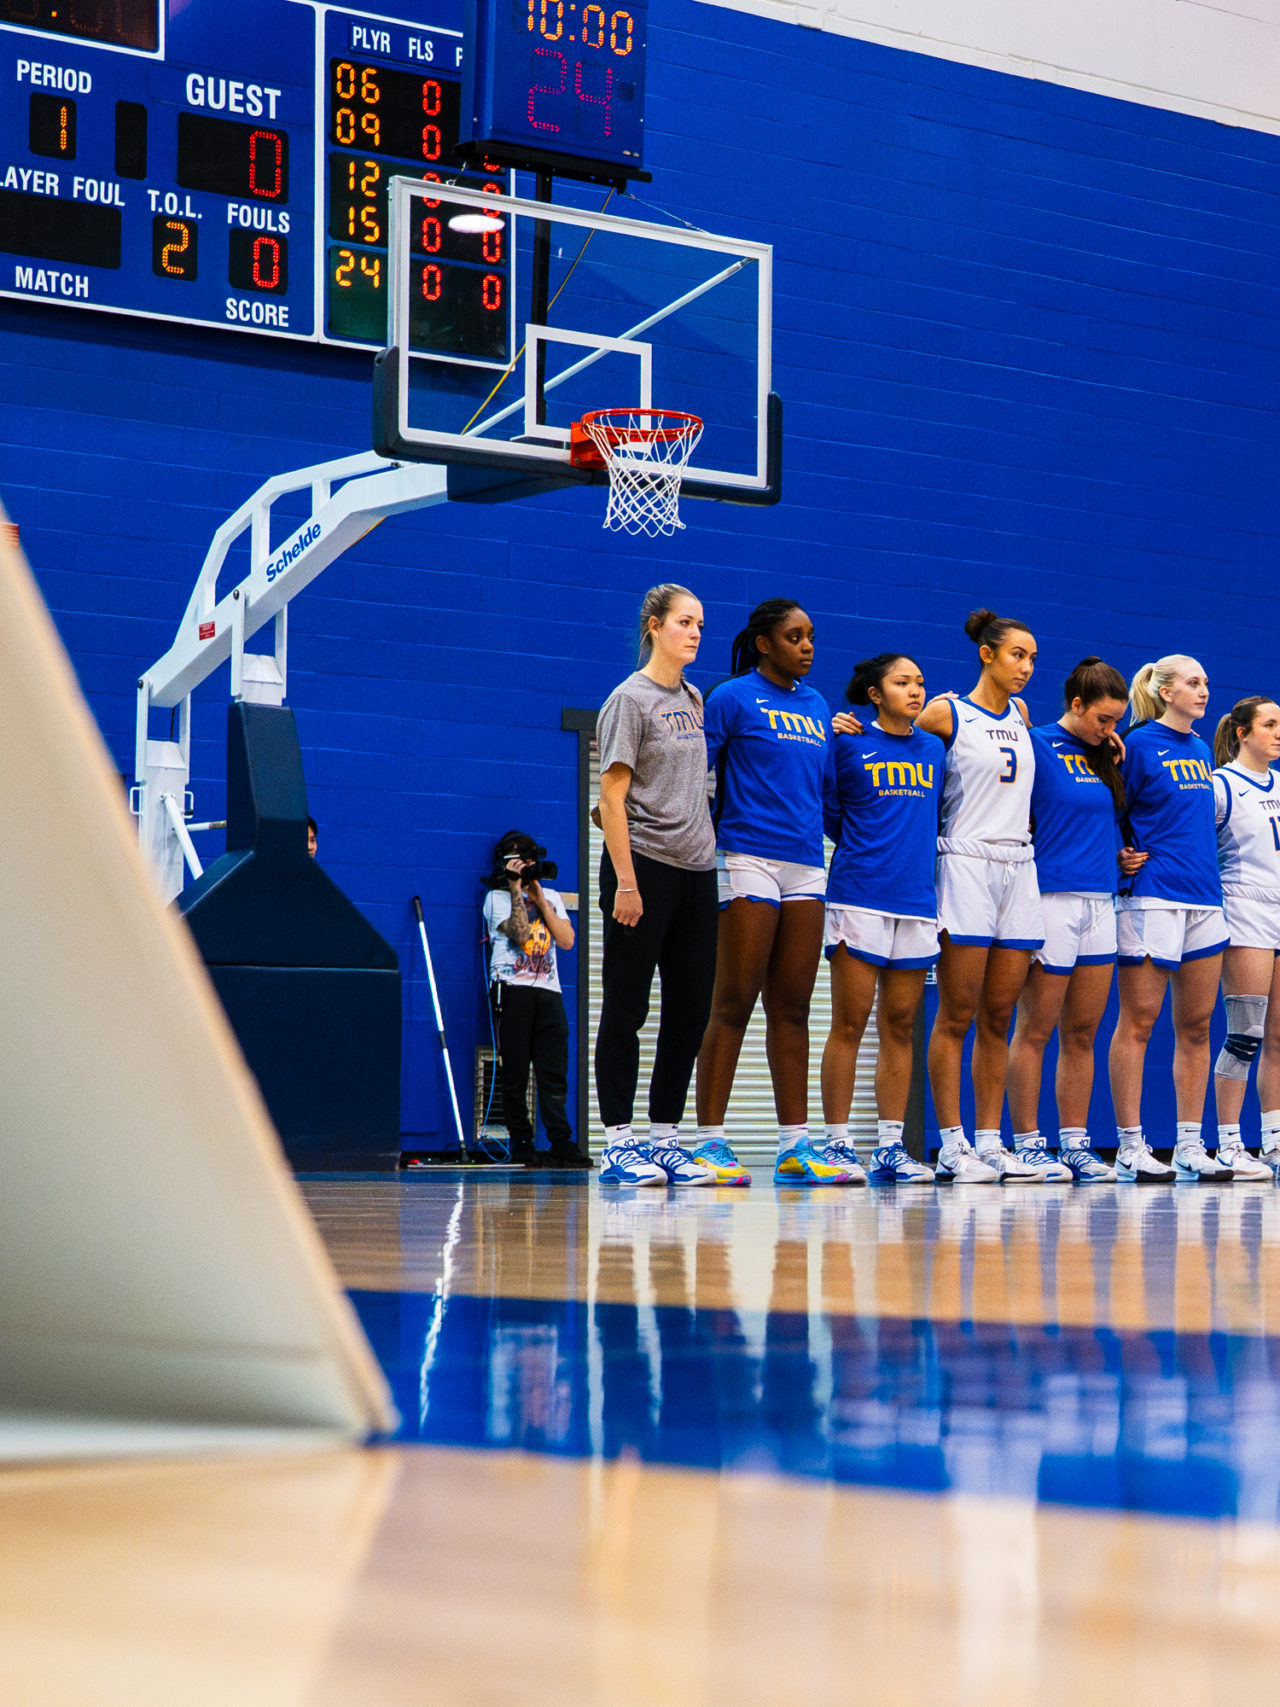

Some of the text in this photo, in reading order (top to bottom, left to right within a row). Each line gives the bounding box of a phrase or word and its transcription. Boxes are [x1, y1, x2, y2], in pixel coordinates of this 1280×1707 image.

[352, 26, 391, 53] PLYR
[408, 37, 434, 62] FLS
[16, 59, 92, 94] PERIOD
[336, 63, 441, 116] 06 0
[530, 47, 614, 136] 24
[186, 73, 281, 119] GUEST
[60, 105, 67, 150] 1
[336, 108, 441, 160] 09 0
[250, 131, 281, 198] 0
[349, 161, 380, 197] 12
[73, 176, 125, 207] FOUL
[147, 189, 203, 219] T.O.L.
[227, 203, 290, 233] FOULS
[349, 206, 380, 243] 15
[422, 217, 441, 252] 0
[162, 221, 189, 274] 2
[253, 236, 279, 289] 0
[15, 266, 89, 298] MATCH
[335, 250, 500, 310] 24 0 0
[226, 298, 289, 327] SCORE
[265, 522, 321, 583] Schelde
[760, 707, 826, 741] TMU
[777, 732, 822, 747] BASKETBALL
[986, 730, 1018, 742] TMU
[864, 761, 933, 789] TMU
[1000, 747, 1018, 784] 3
[1162, 759, 1213, 783] TMU
[878, 788, 926, 798] BASKETBALL
